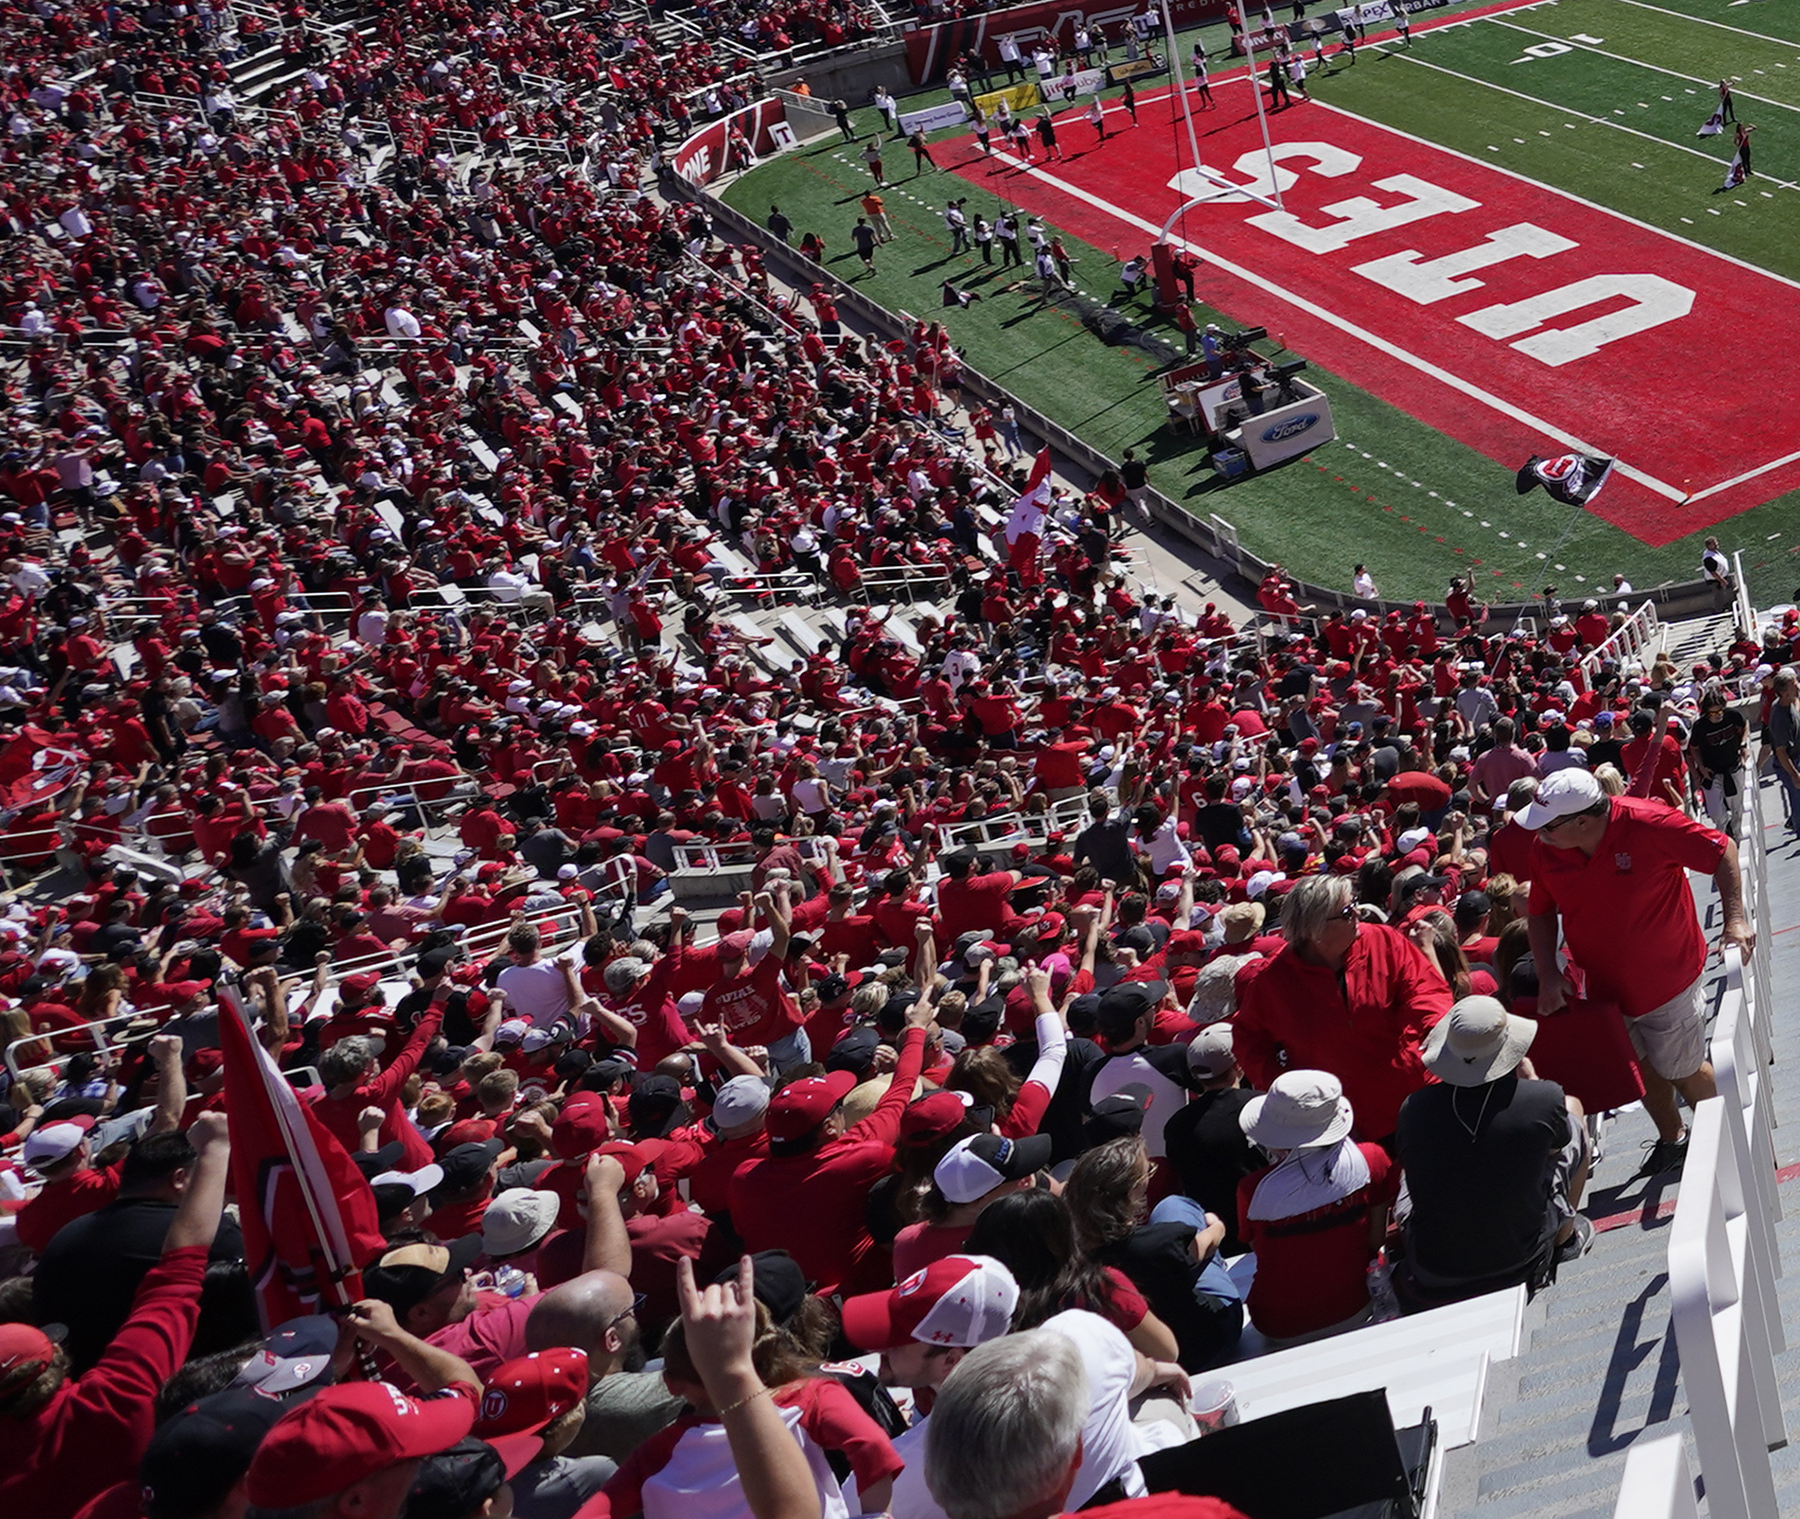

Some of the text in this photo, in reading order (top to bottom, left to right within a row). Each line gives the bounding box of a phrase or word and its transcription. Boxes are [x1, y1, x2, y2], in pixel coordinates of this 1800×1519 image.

[1522, 32, 1604, 59] 10
[776, 127, 790, 143] T
[1167, 141, 1696, 367] UTES
[1272, 416, 1309, 440] Ford
[1414, 623, 1424, 635] 4
[952, 663, 960, 677] 3
[635, 713, 649, 727] 11
[1191, 791, 1208, 808] 6
